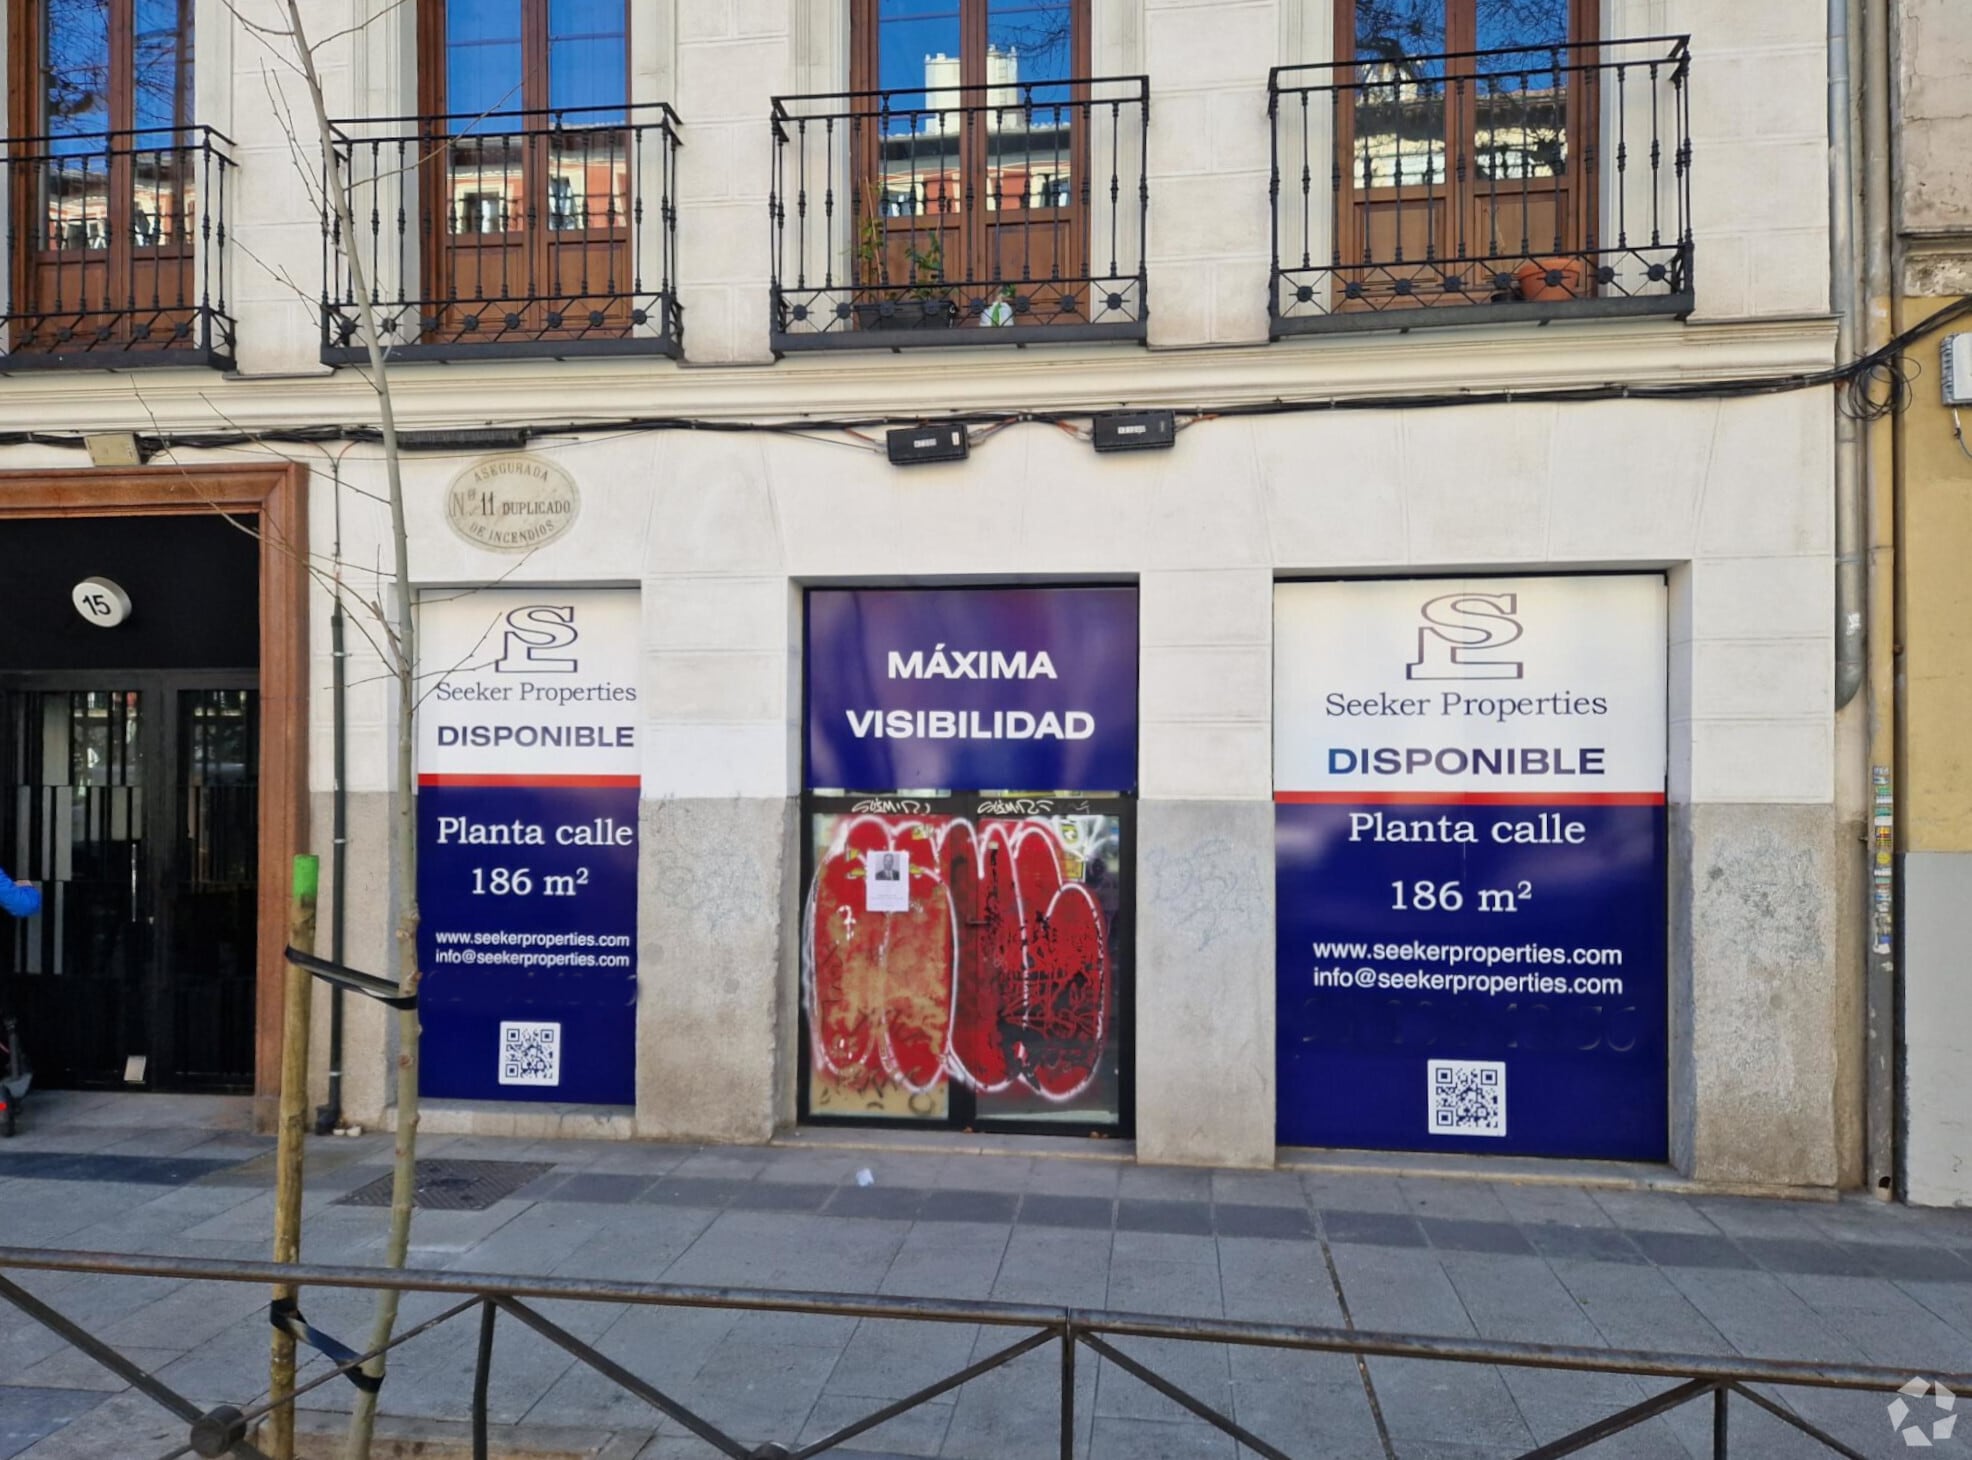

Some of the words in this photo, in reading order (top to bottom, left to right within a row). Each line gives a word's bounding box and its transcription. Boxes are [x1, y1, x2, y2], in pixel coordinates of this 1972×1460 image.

[474, 462, 548, 482] ASEGURADA
[481, 491, 495, 516] 11
[502, 500, 571, 515] DUPLICADO
[470, 522, 486, 537] DE
[489, 519, 555, 544] INCENDIOS
[82, 594, 111, 616] 15
[888, 643, 1057, 679] MÁXIMA
[436, 681, 512, 701] Seeker
[520, 682, 637, 706] Properties
[1326, 691, 1430, 716] Seeker
[1441, 690, 1608, 722] Properties
[438, 726, 635, 748] DISPONIBLE
[846, 710, 1095, 740] VISIBILIDAD
[1328, 748, 1605, 775] DISPONIBLE
[436, 816, 545, 845] Planta
[555, 818, 633, 845] calle
[1348, 813, 1478, 843] Planta
[1491, 813, 1586, 844] calle
[472, 867, 532, 895] 186
[543, 867, 589, 896] m²
[1391, 880, 1463, 911] 186
[1478, 880, 1532, 912] m²
[436, 930, 630, 948] www.seekerproperties.com
[436, 949, 630, 968] info@seekerproperties.com
[1313, 941, 1623, 967] www.seekerproperties.com
[1313, 967, 1623, 996] info@seekerproperties.com
